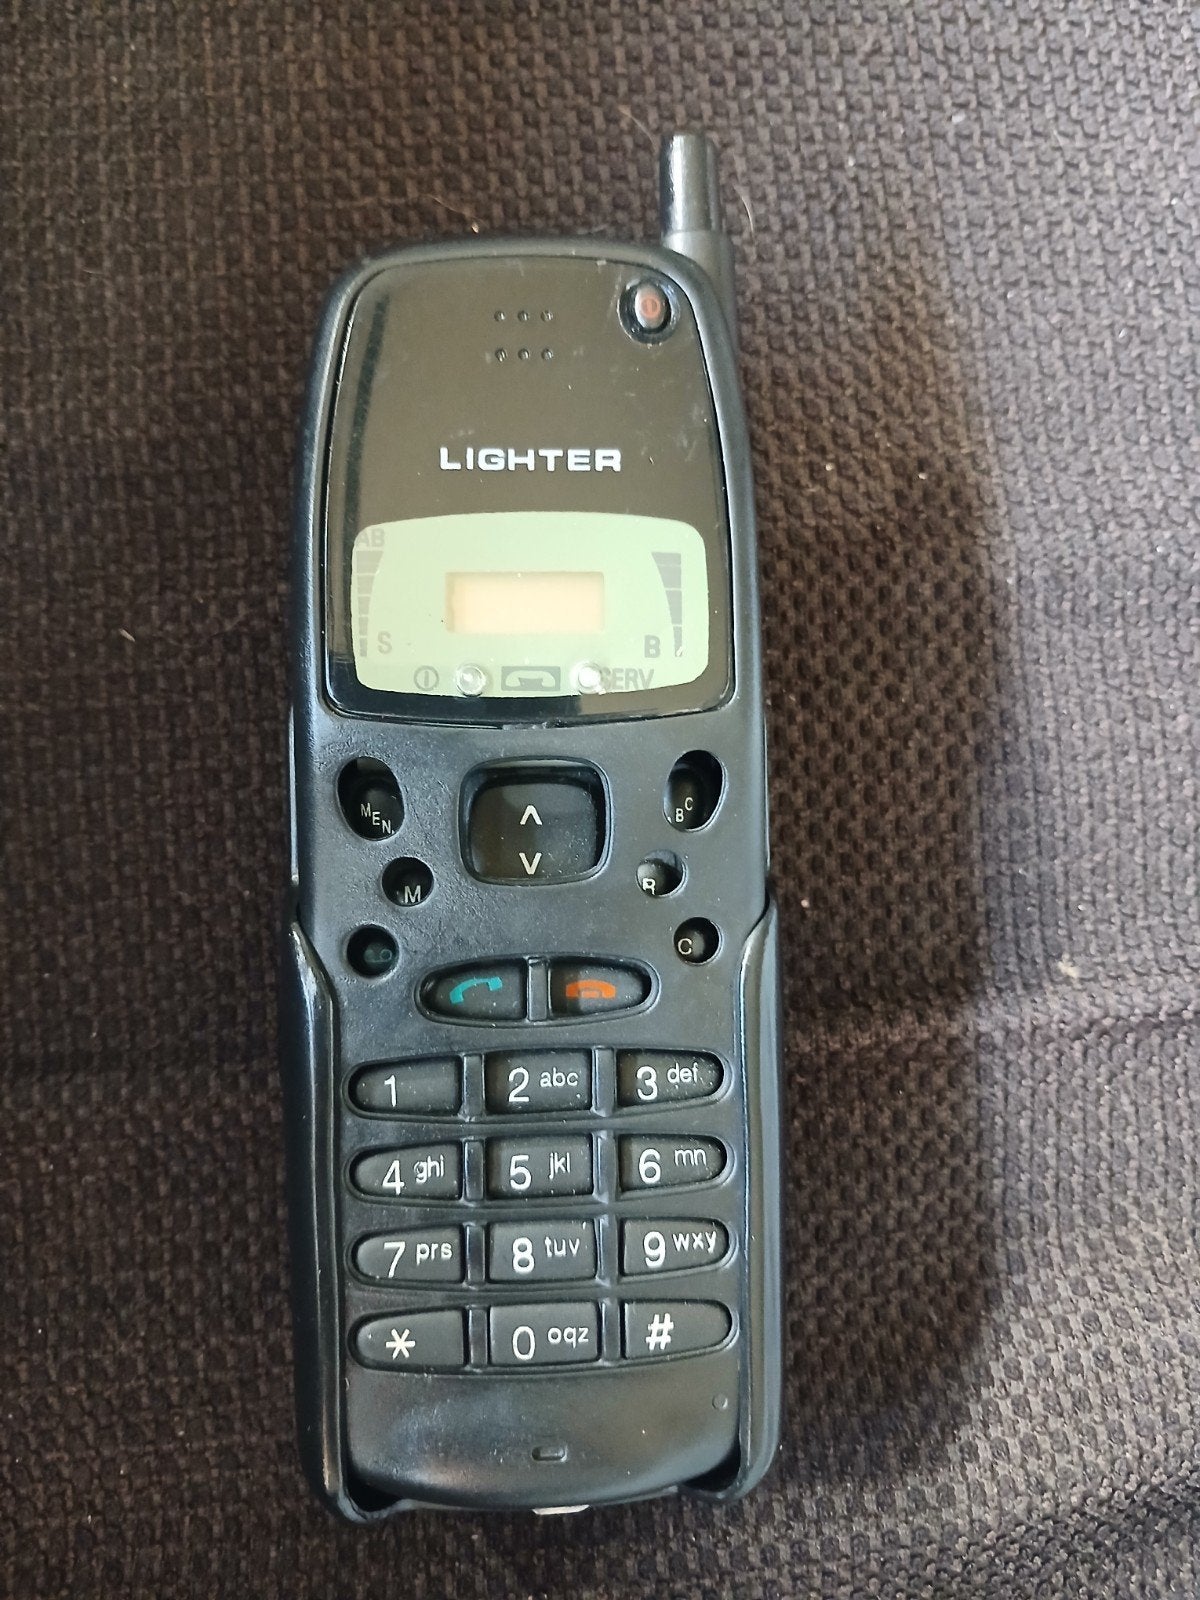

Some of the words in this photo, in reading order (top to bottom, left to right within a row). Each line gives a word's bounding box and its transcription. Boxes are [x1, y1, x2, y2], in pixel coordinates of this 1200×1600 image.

[439, 446, 621, 472] LIGHTER
[378, 631, 393, 655] S
[644, 634, 661, 658] B
[360, 802, 395, 835] MEN
[404, 885, 422, 903] M
[677, 938, 692, 955] C
[384, 1074, 398, 1107] 1
[507, 1066, 530, 1102] 2
[539, 1067, 579, 1088] abc
[636, 1065, 658, 1100] 3
[667, 1063, 699, 1084] def
[382, 1160, 405, 1195] 4
[414, 1154, 445, 1184] ghi
[509, 1154, 532, 1190] 5
[638, 1149, 662, 1184] 6
[674, 1148, 707, 1167] mn
[383, 1241, 406, 1278] 7
[416, 1243, 453, 1265] prs
[512, 1236, 535, 1273] 8
[544, 1236, 580, 1257] tuv
[643, 1231, 666, 1268] 9
[672, 1229, 717, 1253] wxy
[512, 1325, 536, 1360] 0
[547, 1324, 590, 1348] oqz
[645, 1312, 675, 1351] #
